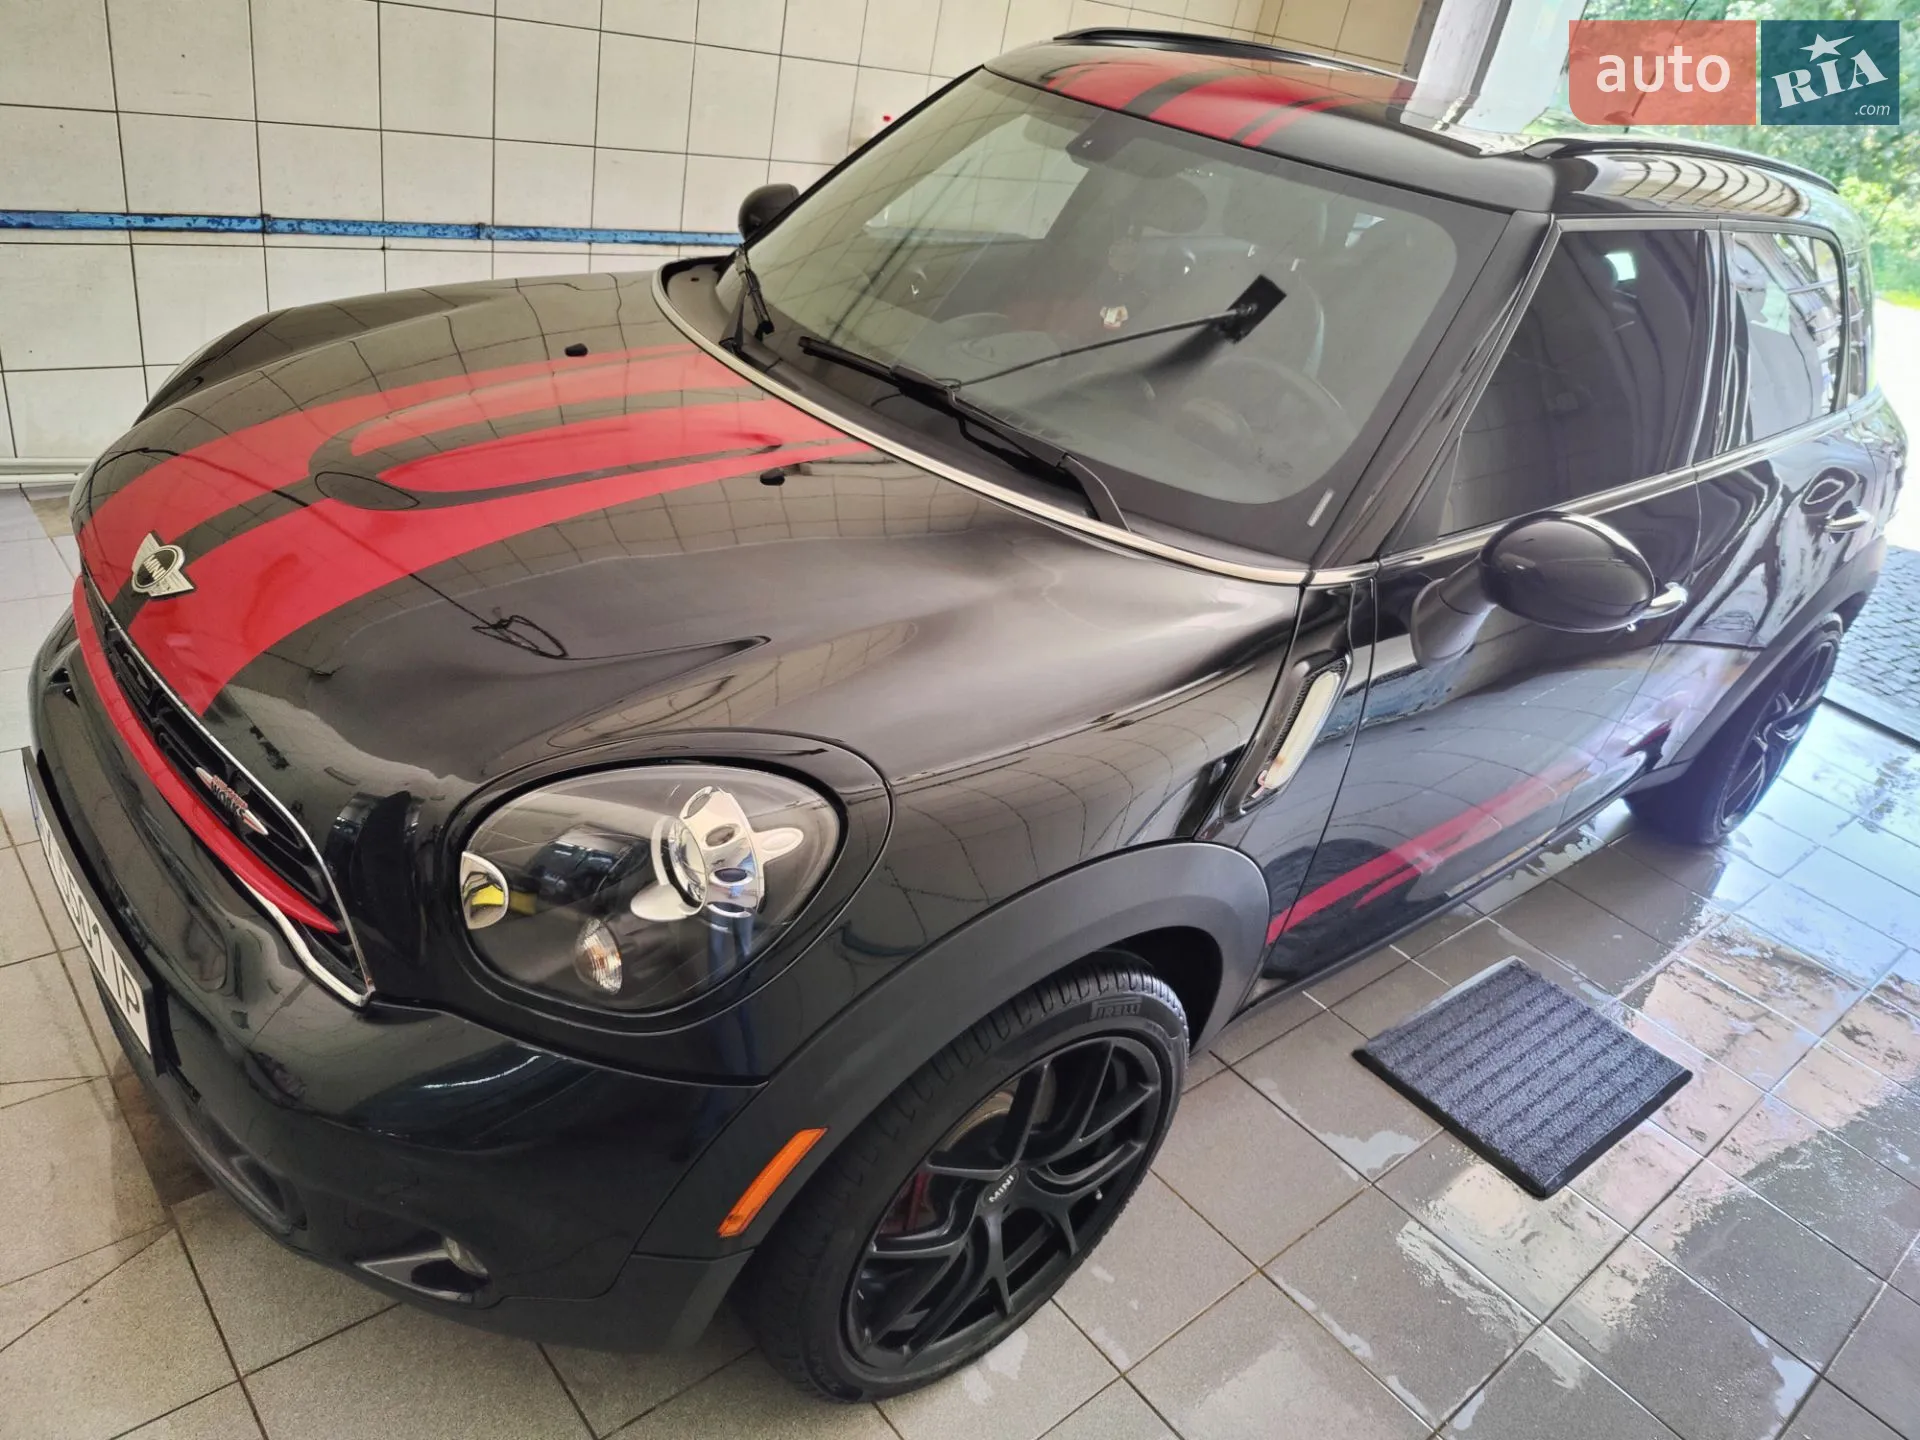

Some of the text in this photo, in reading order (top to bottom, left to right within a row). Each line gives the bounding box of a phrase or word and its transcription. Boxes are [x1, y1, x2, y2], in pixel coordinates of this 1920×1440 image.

[143, 554, 167, 581] MINI
[1089, 996, 1143, 1021] PIRELLI
[988, 1174, 1014, 1203] MINI
